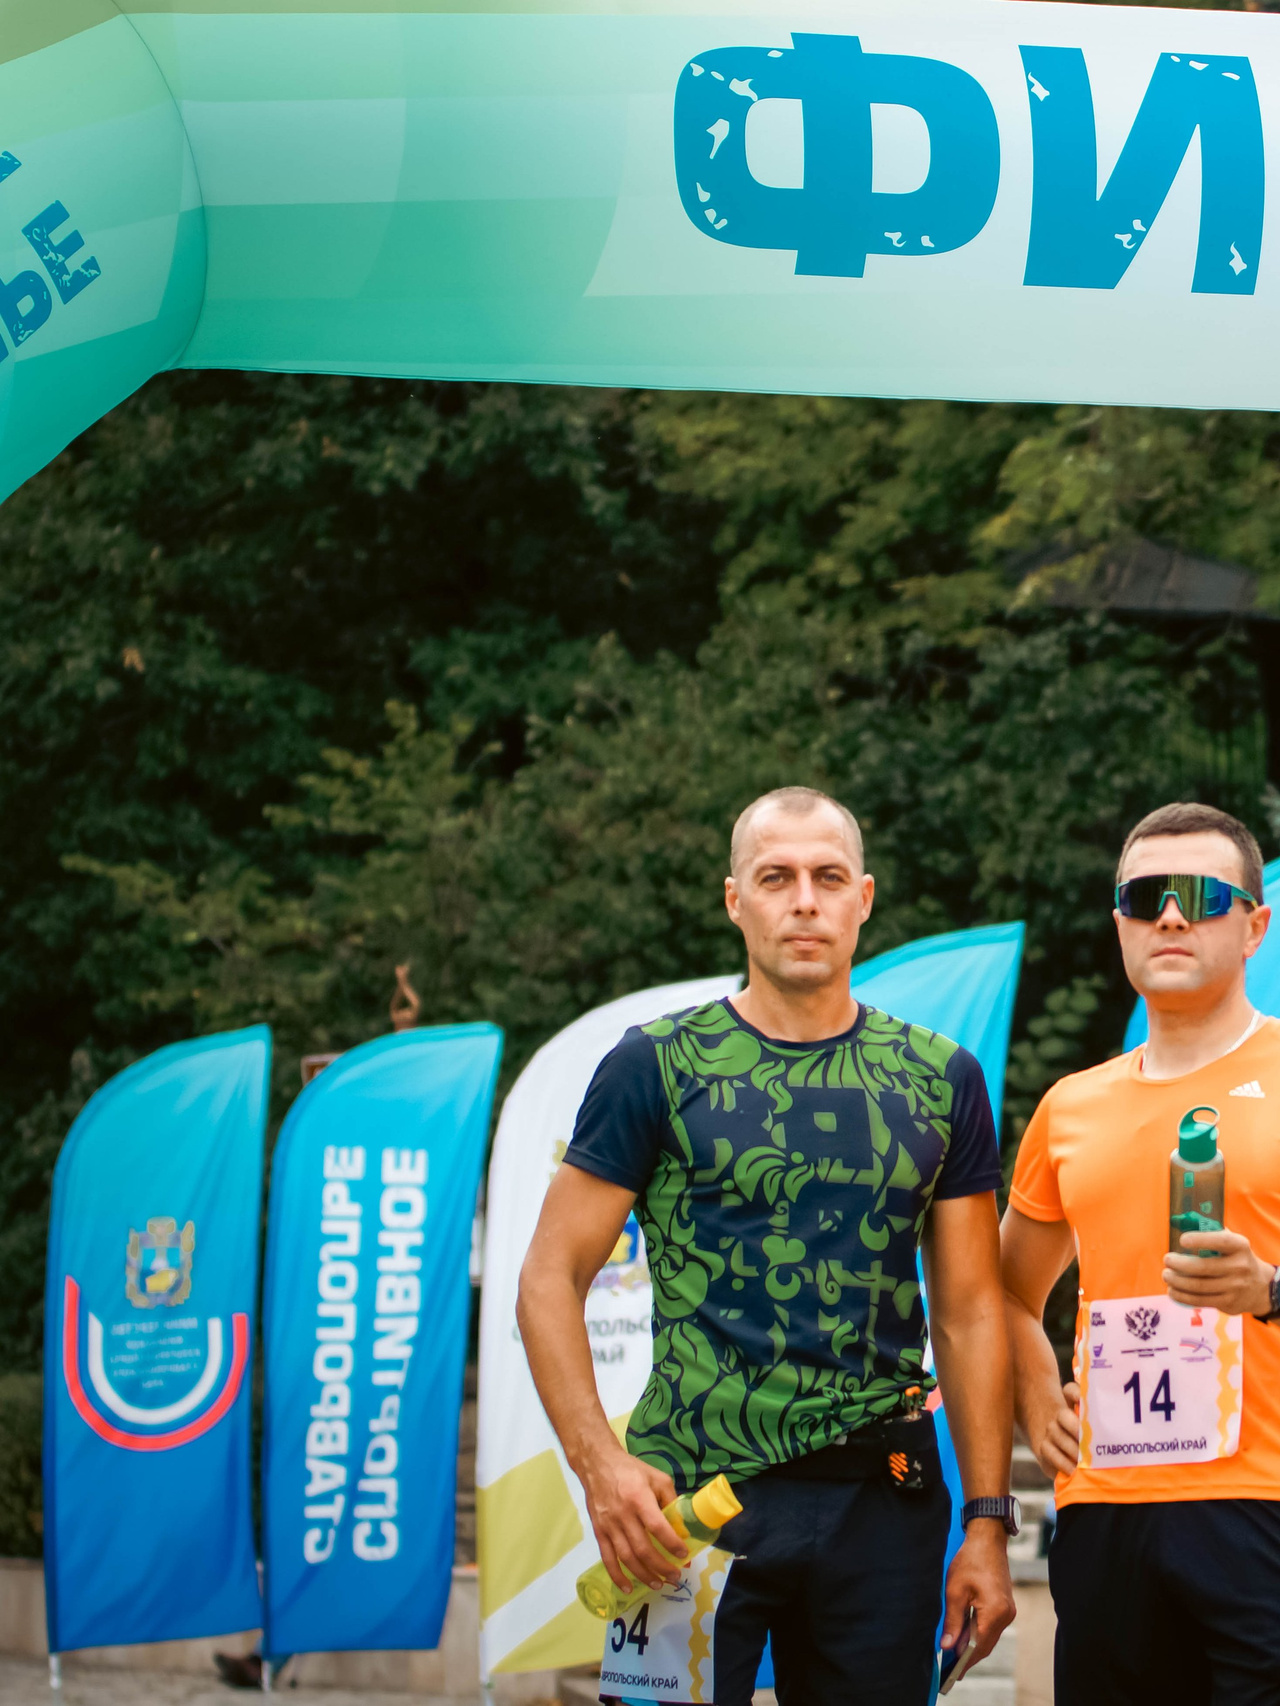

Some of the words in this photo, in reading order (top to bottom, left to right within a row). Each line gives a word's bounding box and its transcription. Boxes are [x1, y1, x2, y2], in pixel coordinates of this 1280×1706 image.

[0, 200, 102, 364] ЬЕ
[1123, 1368, 1176, 1424] 14
[1095, 1437, 1179, 1456] СТАВРОПОЛЬСКИЙ
[1180, 1435, 1207, 1450] КРАЙ
[651, 1675, 679, 1690] КРАЙ
